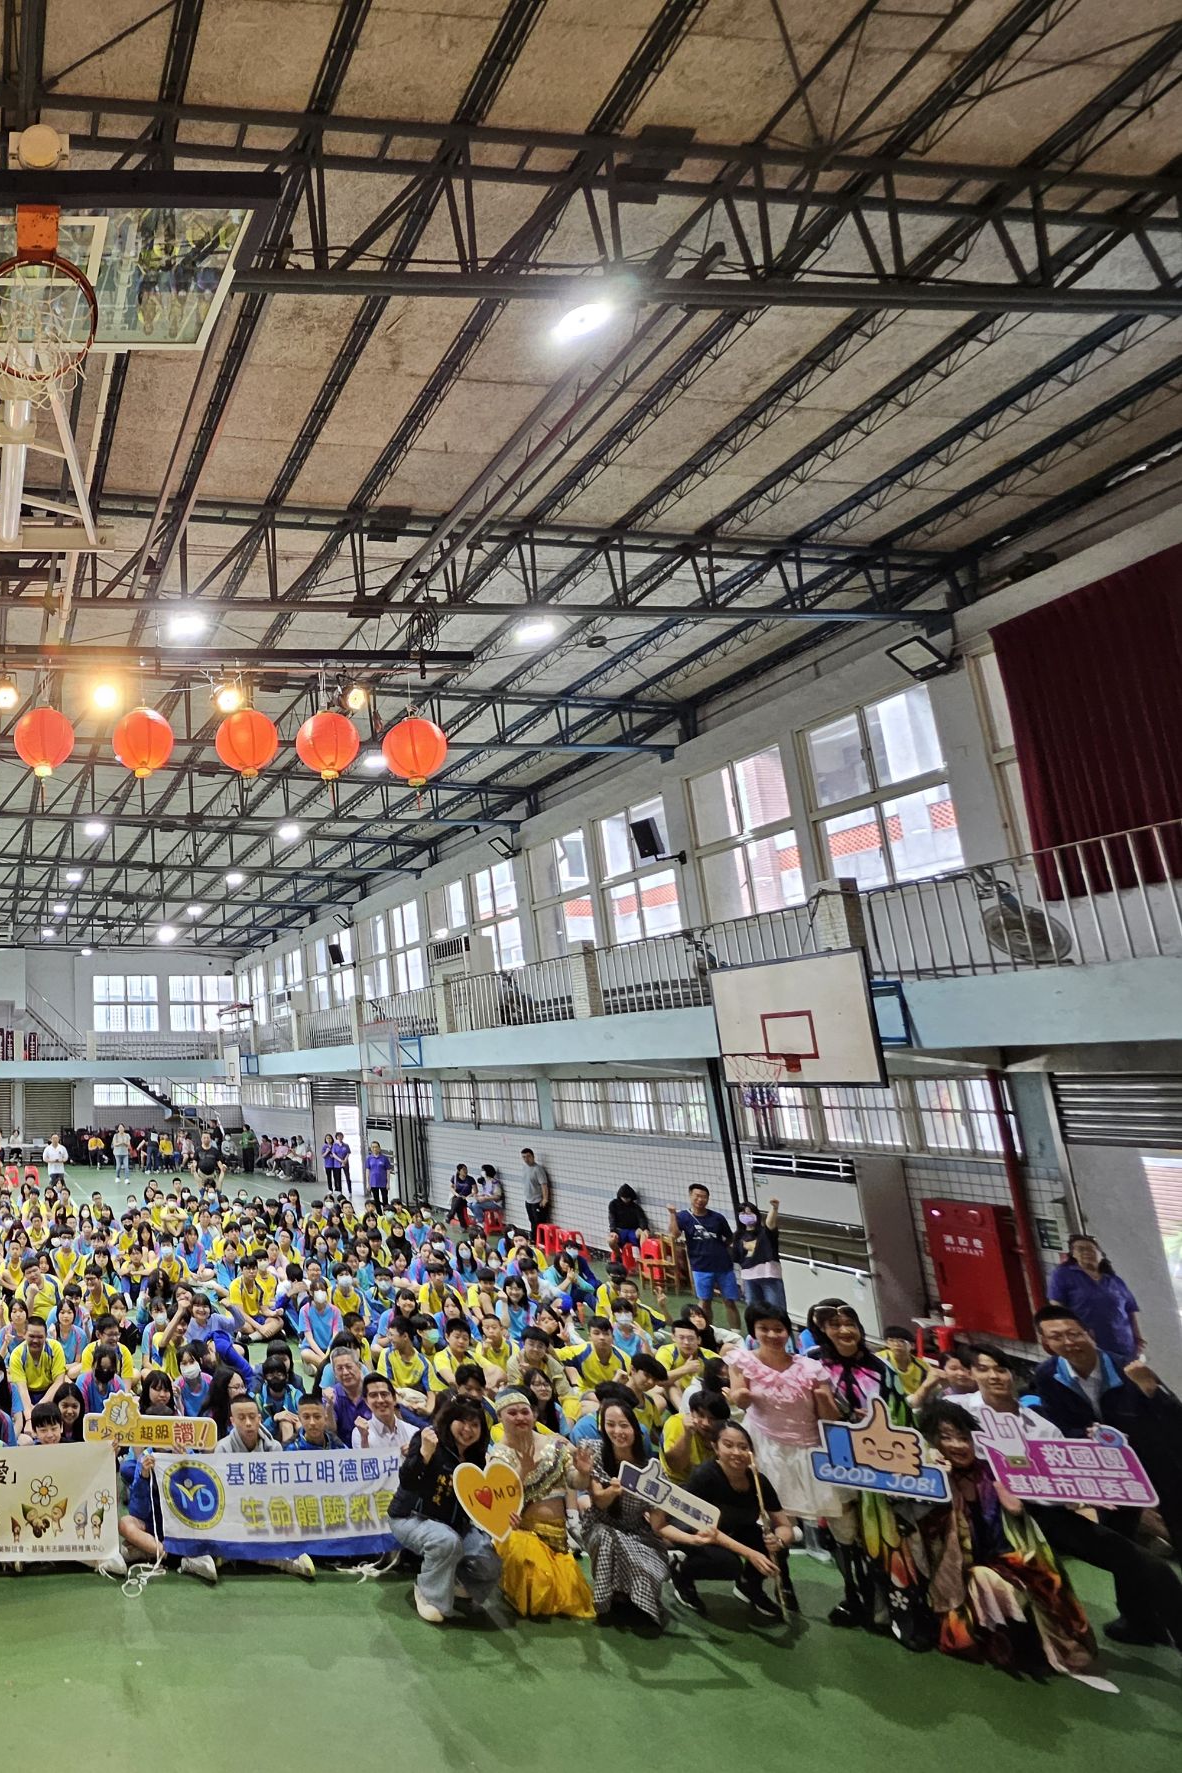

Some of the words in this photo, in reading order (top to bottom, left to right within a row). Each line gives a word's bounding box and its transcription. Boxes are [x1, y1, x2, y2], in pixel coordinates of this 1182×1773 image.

[945, 1246, 984, 1257] HYDRANT
[1041, 1444, 1130, 1470] 救國團
[226, 1456, 399, 1486] 基隆市立明德國中
[819, 1463, 877, 1484] GOOD
[886, 1475, 936, 1493] JOB!
[1006, 1474, 1151, 1501] 基隆市團委會
